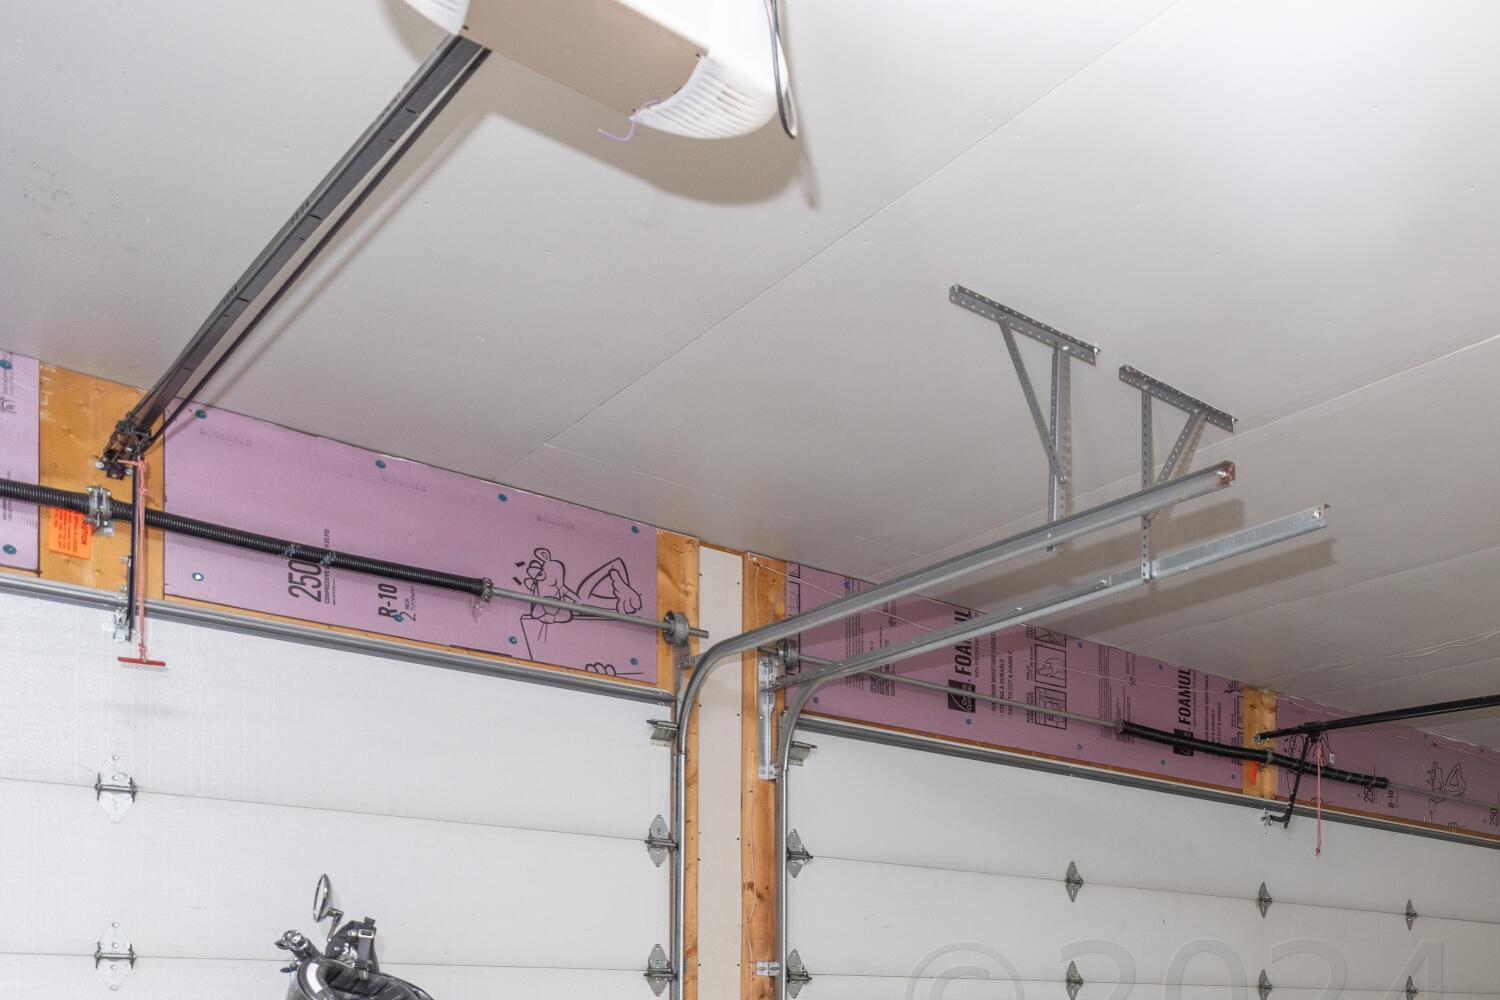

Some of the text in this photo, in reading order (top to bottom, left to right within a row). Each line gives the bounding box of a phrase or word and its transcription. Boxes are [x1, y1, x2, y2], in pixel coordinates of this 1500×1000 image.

[288, 560, 321, 603] 250
[378, 584, 397, 618] R-10
[1489, 807, 1498, 827] 250
